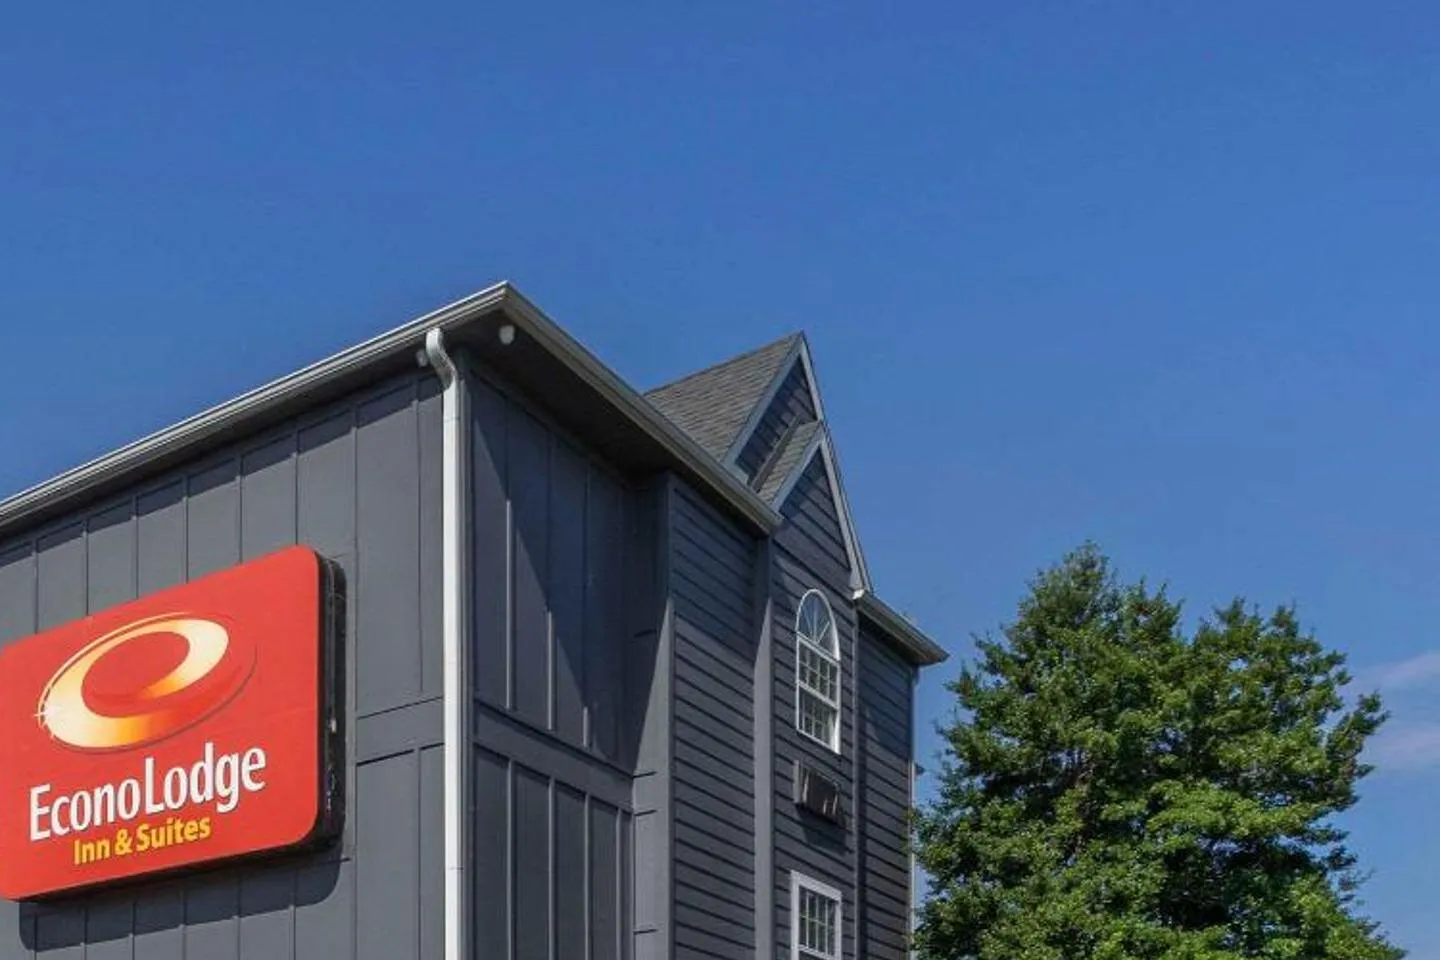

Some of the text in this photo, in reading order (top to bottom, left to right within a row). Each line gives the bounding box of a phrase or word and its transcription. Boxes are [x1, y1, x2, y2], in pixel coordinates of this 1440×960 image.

[29, 742, 267, 841] EconoLodge
[73, 815, 211, 865] Inn & Suites
